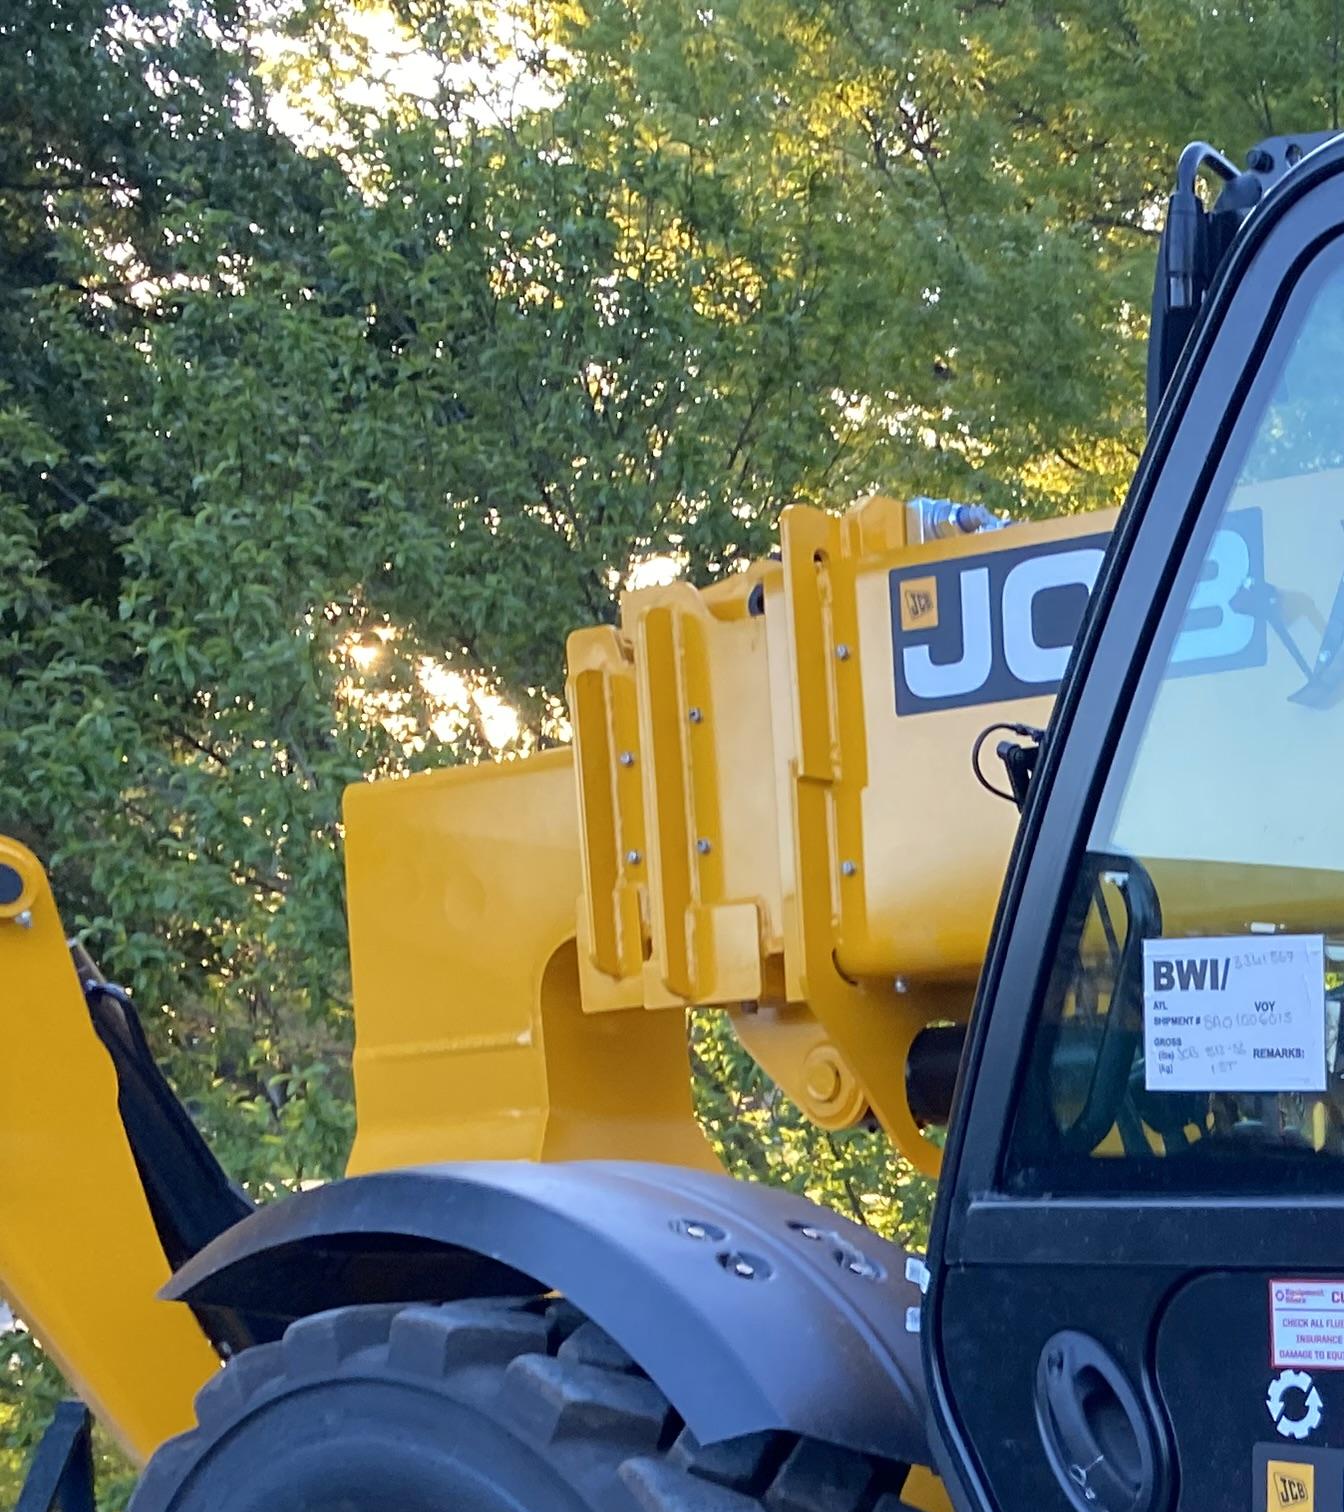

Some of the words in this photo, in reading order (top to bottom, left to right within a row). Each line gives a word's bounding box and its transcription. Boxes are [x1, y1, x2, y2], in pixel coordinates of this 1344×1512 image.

[1153, 958, 1230, 992] BWI/
[1254, 1001, 1275, 1012] VOY
[1154, 1017, 1193, 1026] SHIPMENT
[1154, 1037, 1182, 1047] GROSS
[1282, 1318, 1309, 1328] CHECK
[1311, 1319, 1324, 1328] ALL
[1296, 1335, 1343, 1345] INSURANCE
[1279, 1350, 1312, 1359] DAMAGE
[1315, 1350, 1324, 1360] TO
[1279, 1477, 1306, 1503] JCB
